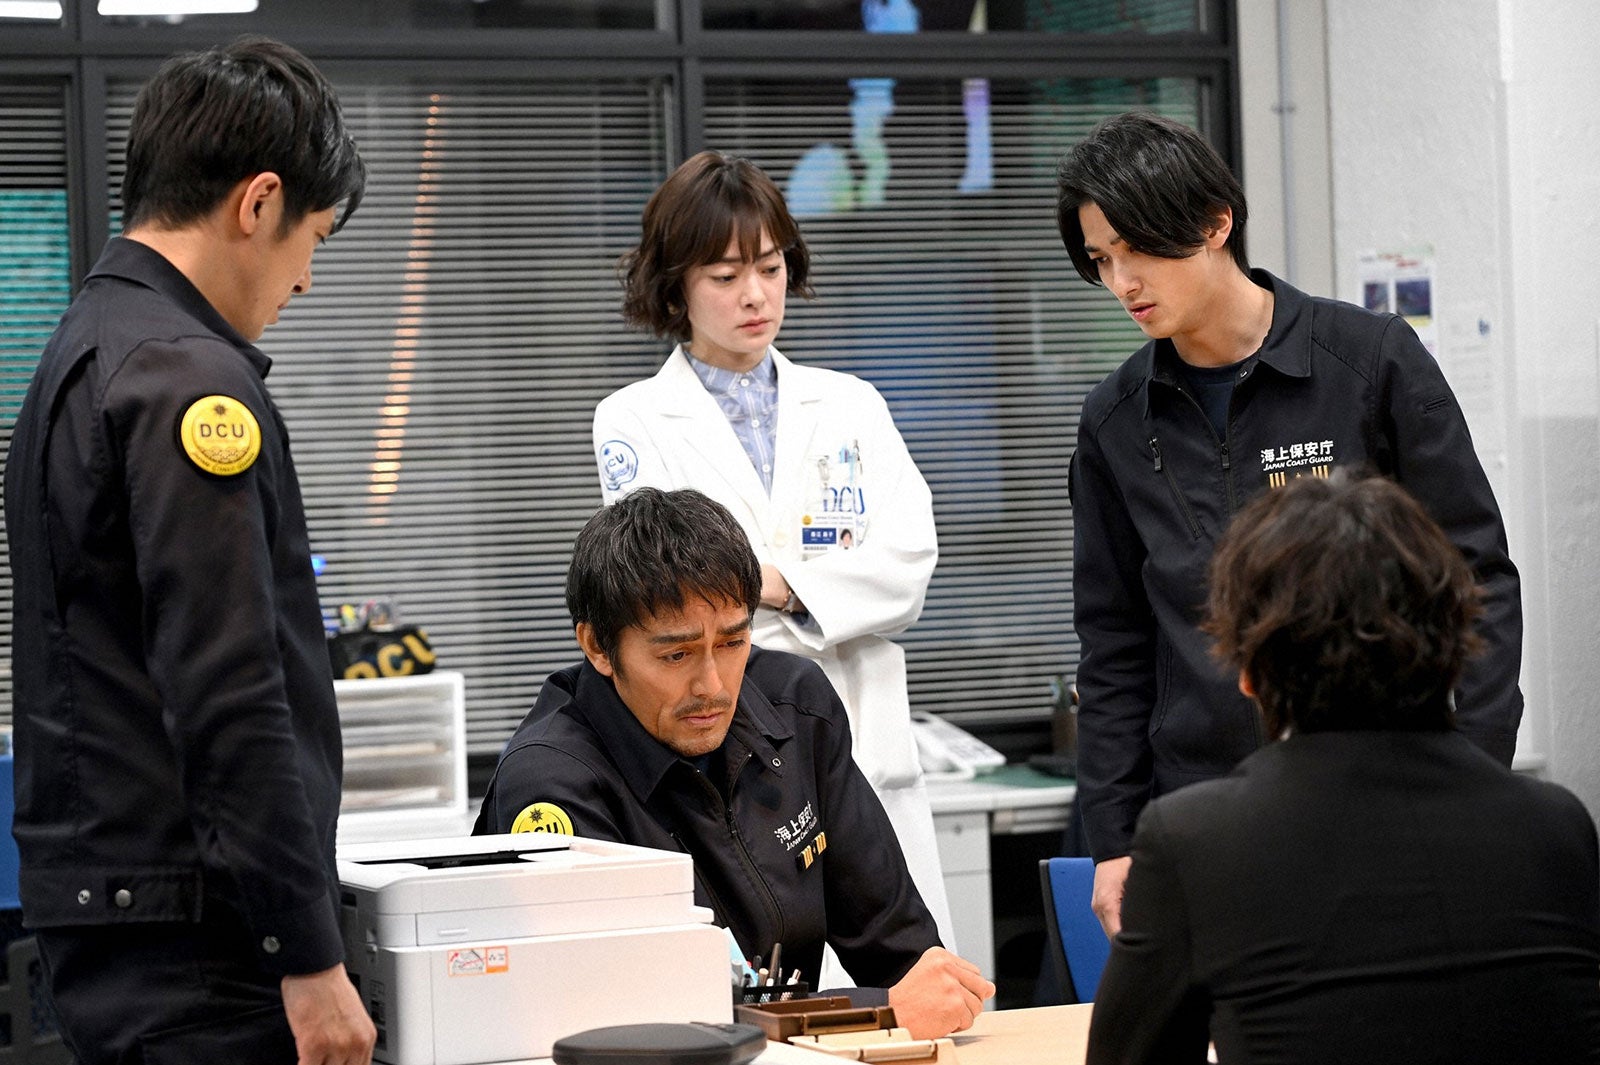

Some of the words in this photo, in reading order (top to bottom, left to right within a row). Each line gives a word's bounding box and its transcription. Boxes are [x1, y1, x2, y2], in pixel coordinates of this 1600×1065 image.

[200, 423, 245, 439] DCU
[1260, 440, 1334, 464] 海上保安庁
[1263, 462, 1285, 471] JAPAN
[1286, 458, 1308, 467] COAST
[1308, 455, 1334, 464] GUARD
